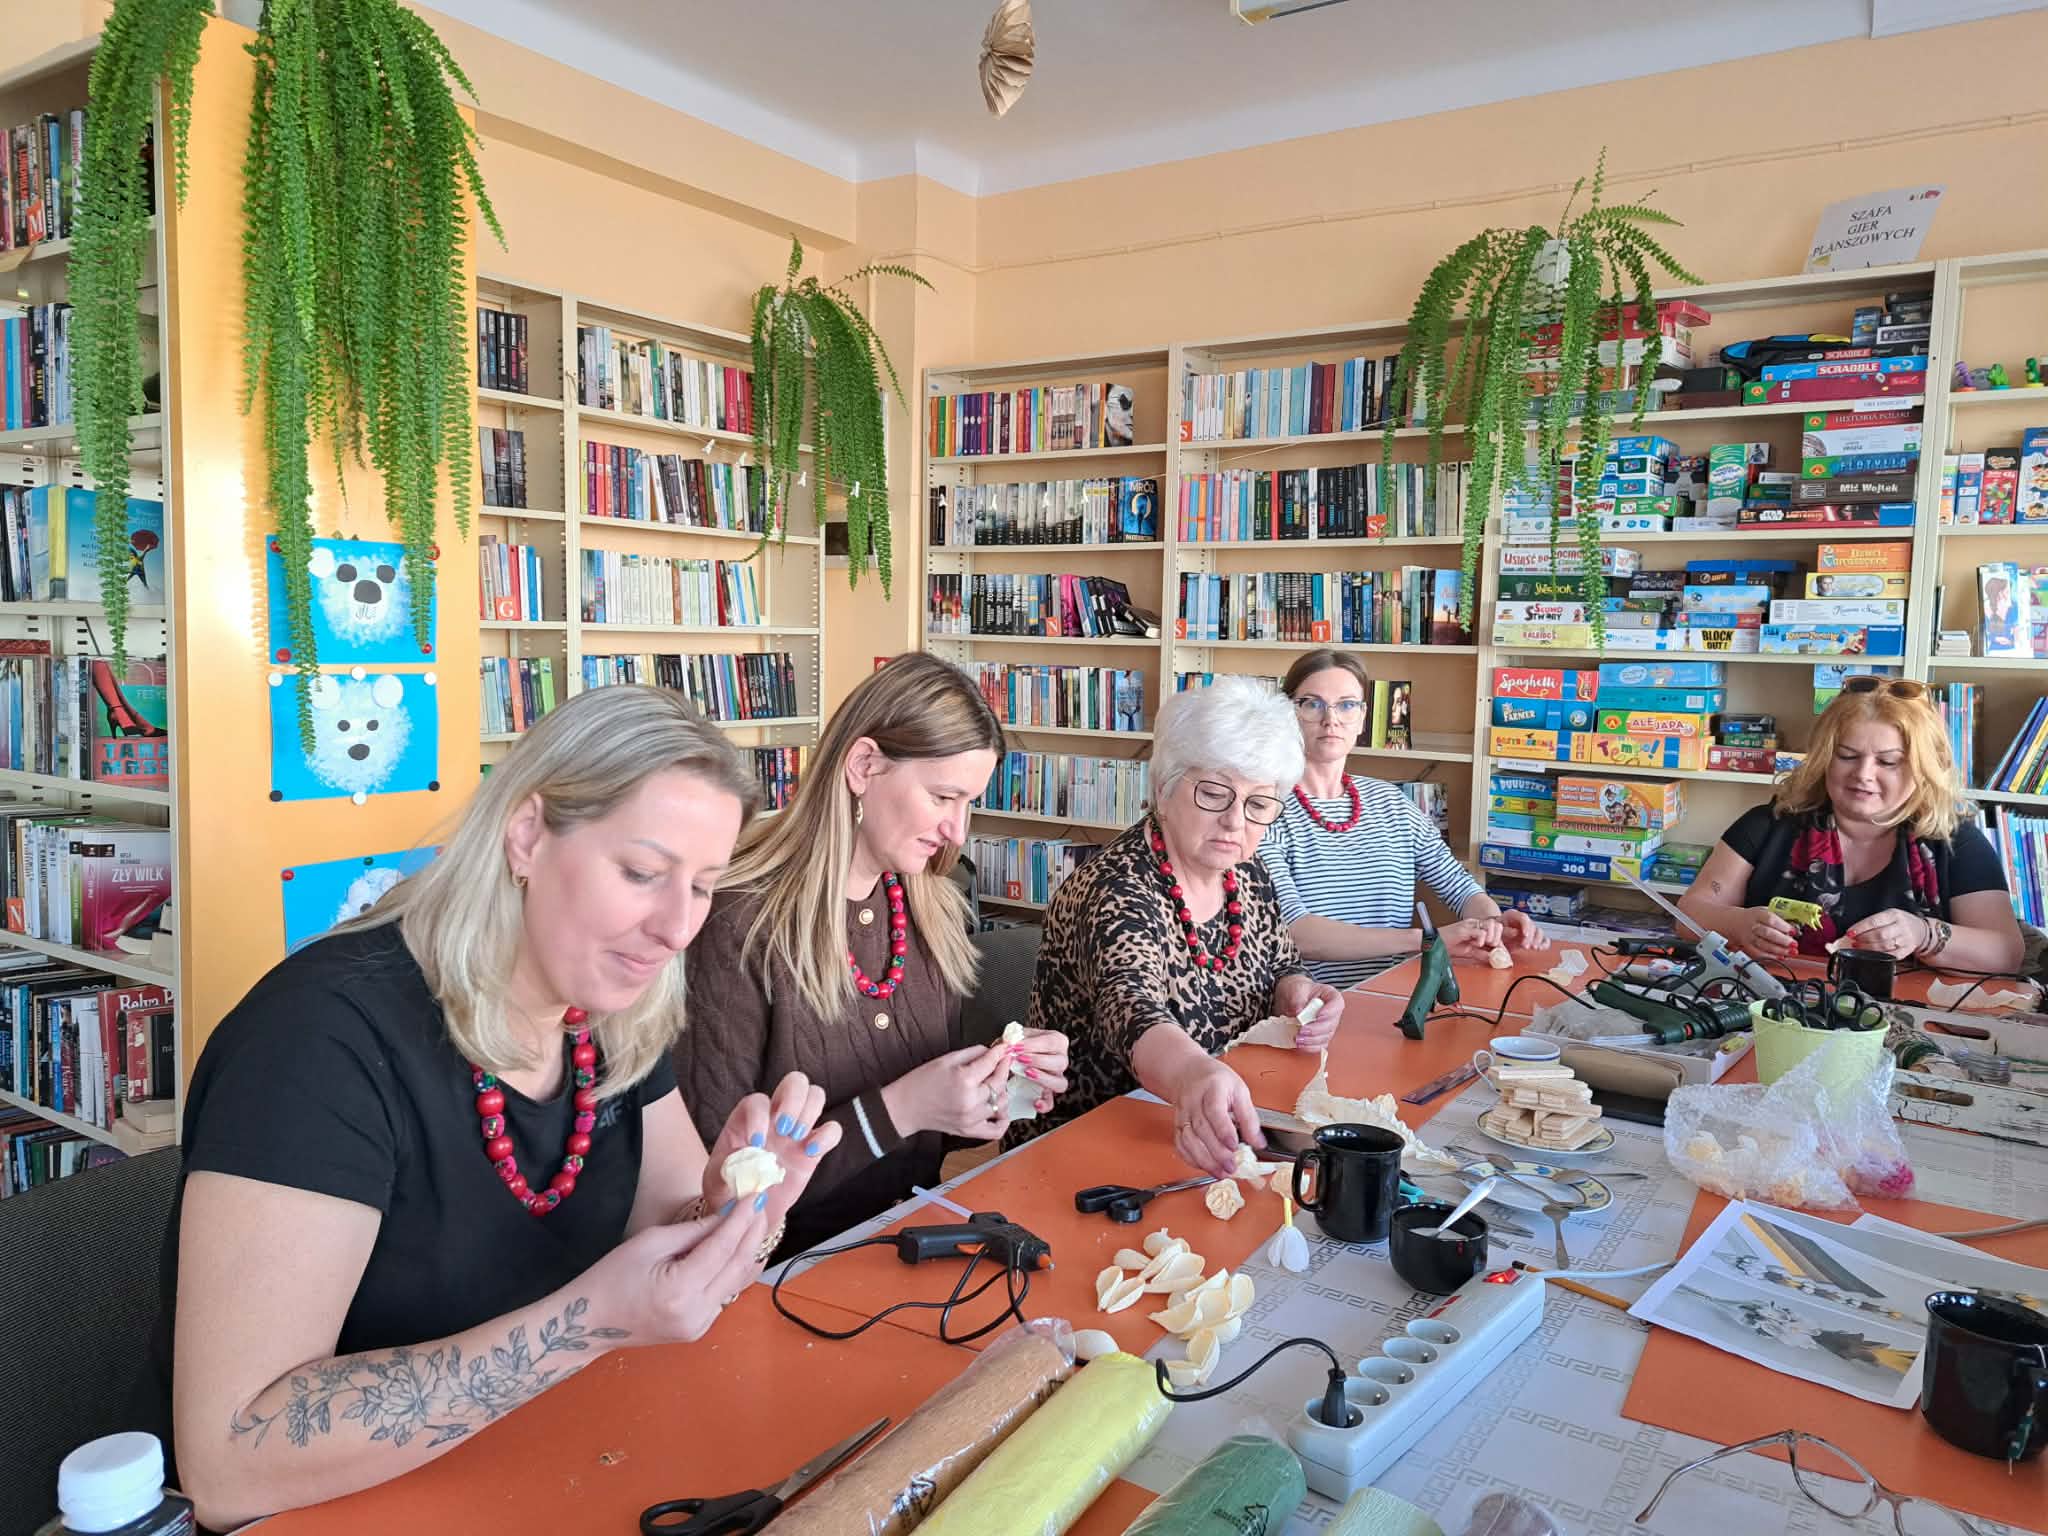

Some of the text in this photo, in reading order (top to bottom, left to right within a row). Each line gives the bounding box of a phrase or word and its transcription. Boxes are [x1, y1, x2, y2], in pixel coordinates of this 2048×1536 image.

[1849, 205, 1892, 222] SZAFA
[1847, 219, 1879, 235] GIER
[1812, 226, 1915, 256] PLANSZOWYCH
[1825, 349, 1871, 360] SCRABBLE
[1818, 363, 1879, 375] SCRABBLE
[1840, 458, 1906, 471] FLOTYLLA
[1862, 483, 1898, 493] Wojtek
[499, 600, 514, 617] G
[1315, 625, 1326, 638] T
[1701, 630, 1735, 641] BLOCK
[1500, 674, 1556, 692] Spaghetti
[1632, 717, 1684, 729] ALE JAPA
[112, 866, 163, 883] ZŁY WILK
[1562, 863, 1585, 874] 300
[1010, 884, 1019, 897] R
